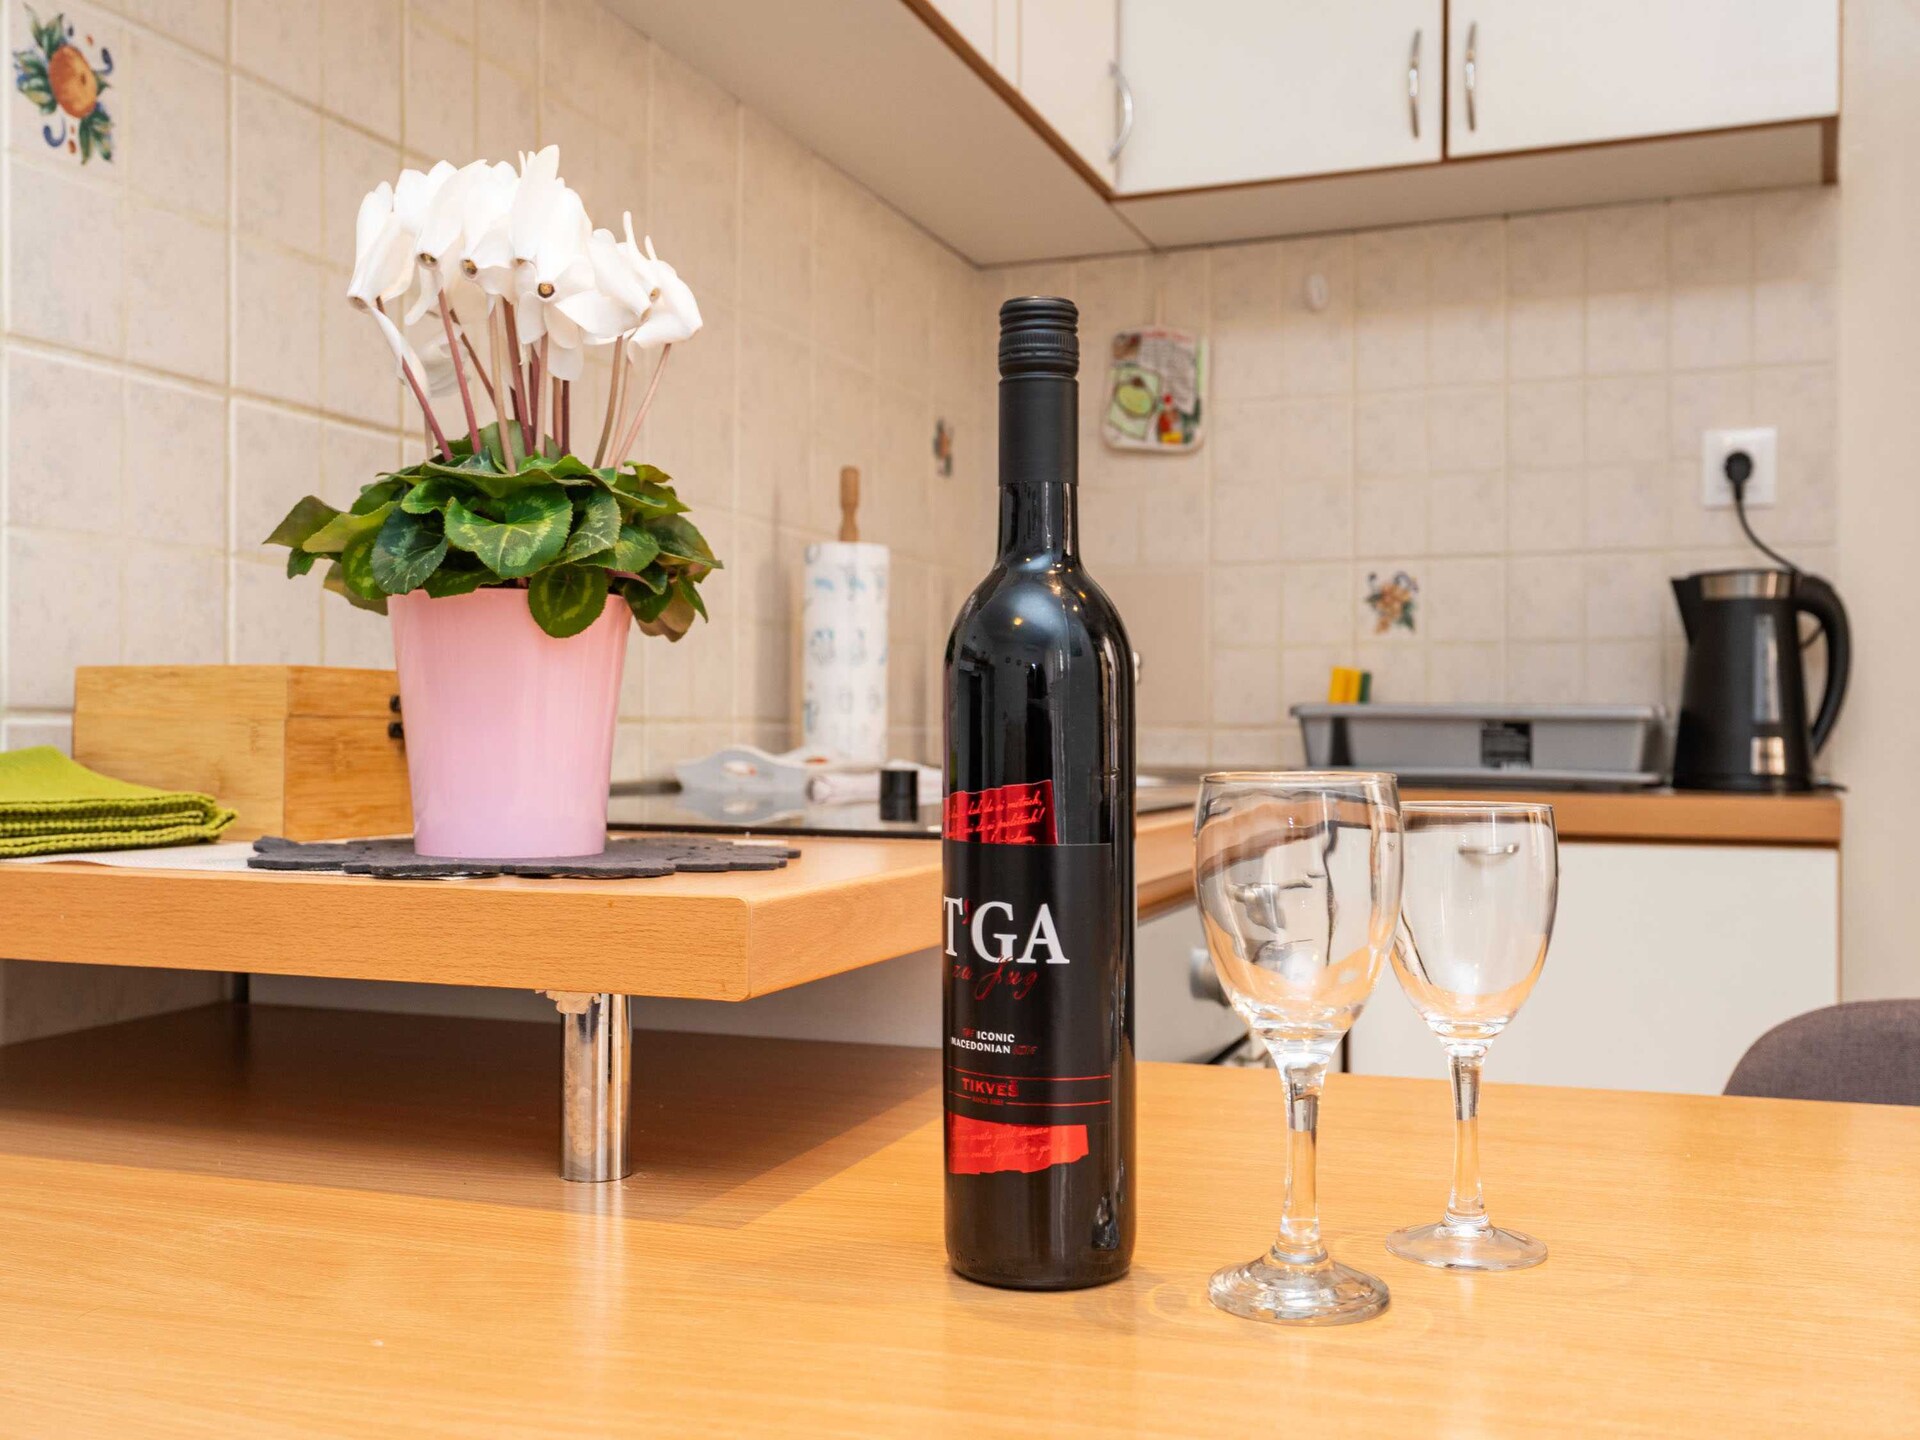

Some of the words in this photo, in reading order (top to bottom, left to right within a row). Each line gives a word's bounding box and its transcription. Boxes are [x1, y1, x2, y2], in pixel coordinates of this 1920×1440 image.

[950, 1036, 1011, 1054] MACEDONIAN
[976, 1030, 1015, 1043] ICONIC
[961, 1077, 1019, 1097] TIKVEŠ
